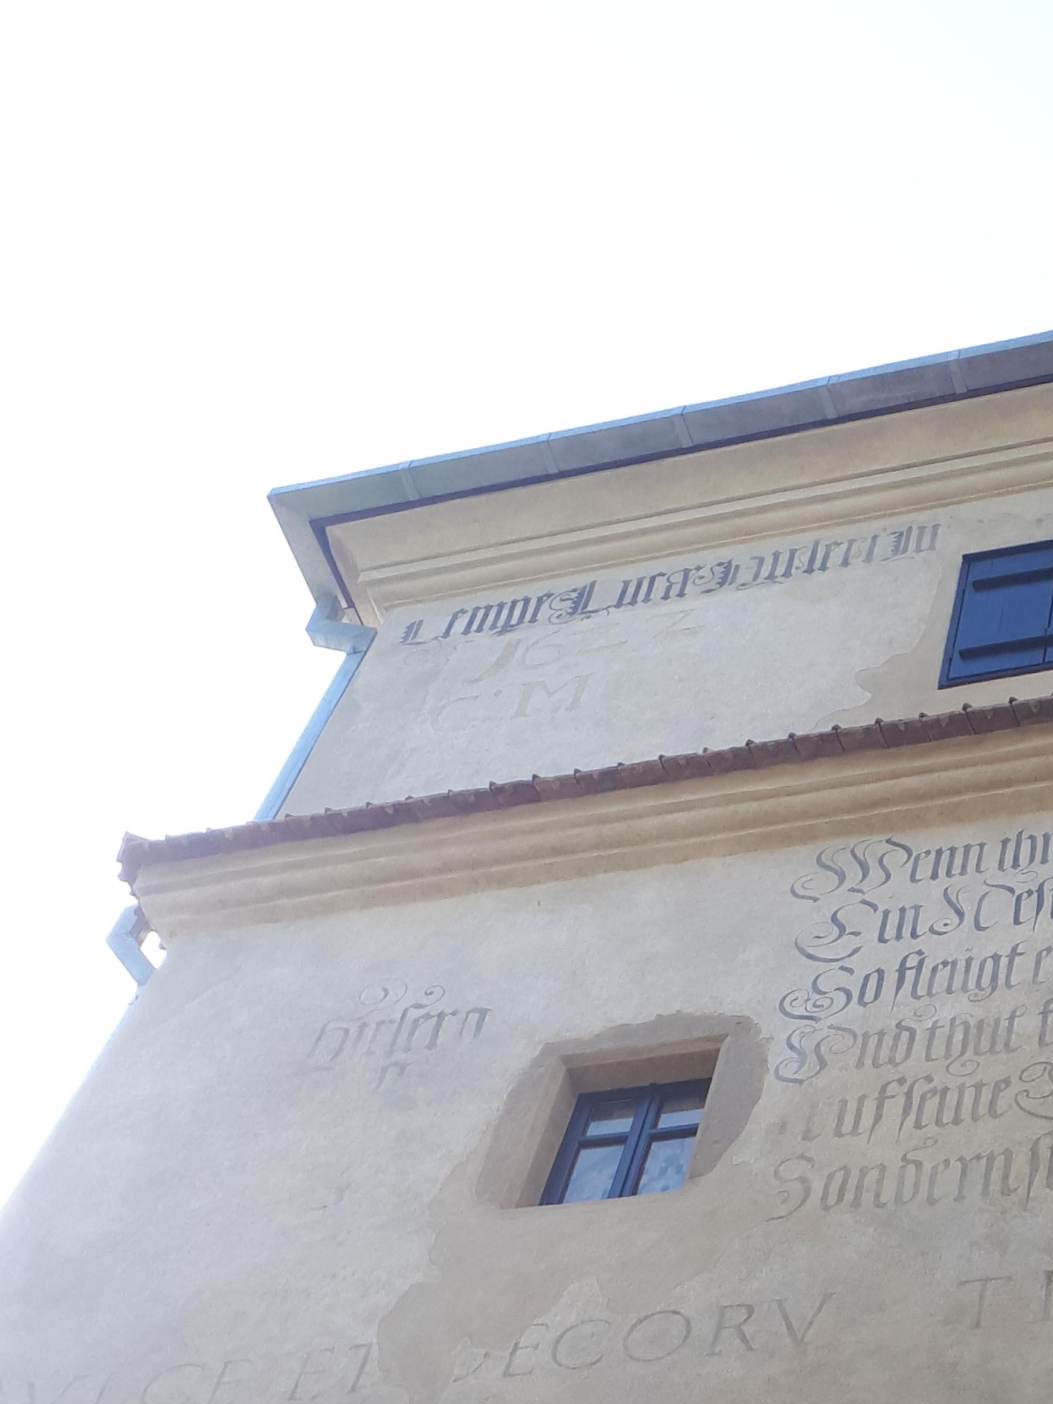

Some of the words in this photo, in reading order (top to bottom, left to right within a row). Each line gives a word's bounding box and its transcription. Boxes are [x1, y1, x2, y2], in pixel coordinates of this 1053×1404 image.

[789, 836, 986, 903] Wenn
[795, 898, 930, 963] Ein
[778, 964, 885, 1023] So
[766, 1137, 1020, 1222] Sondern
